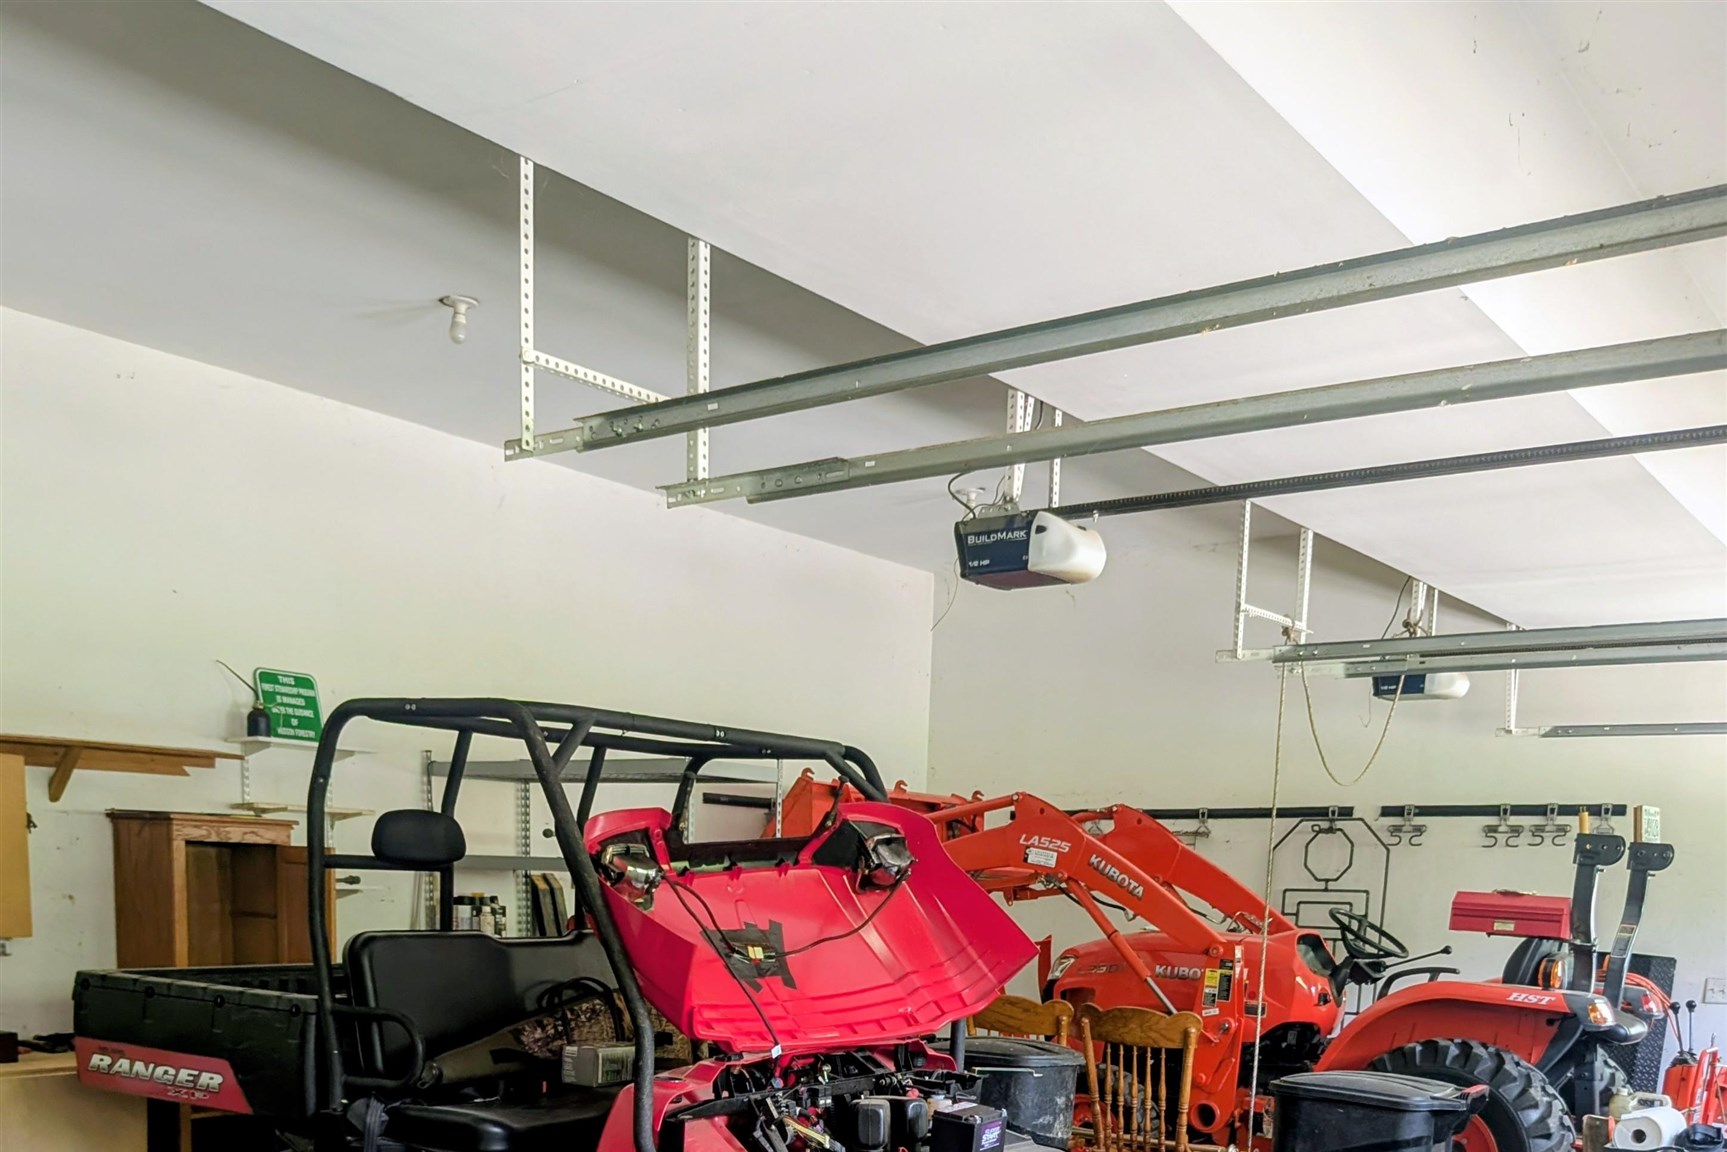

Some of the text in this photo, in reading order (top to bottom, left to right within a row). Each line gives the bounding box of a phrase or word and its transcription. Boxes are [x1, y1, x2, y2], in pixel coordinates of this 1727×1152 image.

[278, 675, 295, 685] THIS
[291, 718, 298, 726] OF
[1019, 834, 1071, 853] LA525
[1088, 853, 1144, 899] KUBOTA
[1154, 964, 1204, 981] KUBO
[1505, 992, 1556, 1005] HST
[88, 1053, 224, 1093] RANGER
